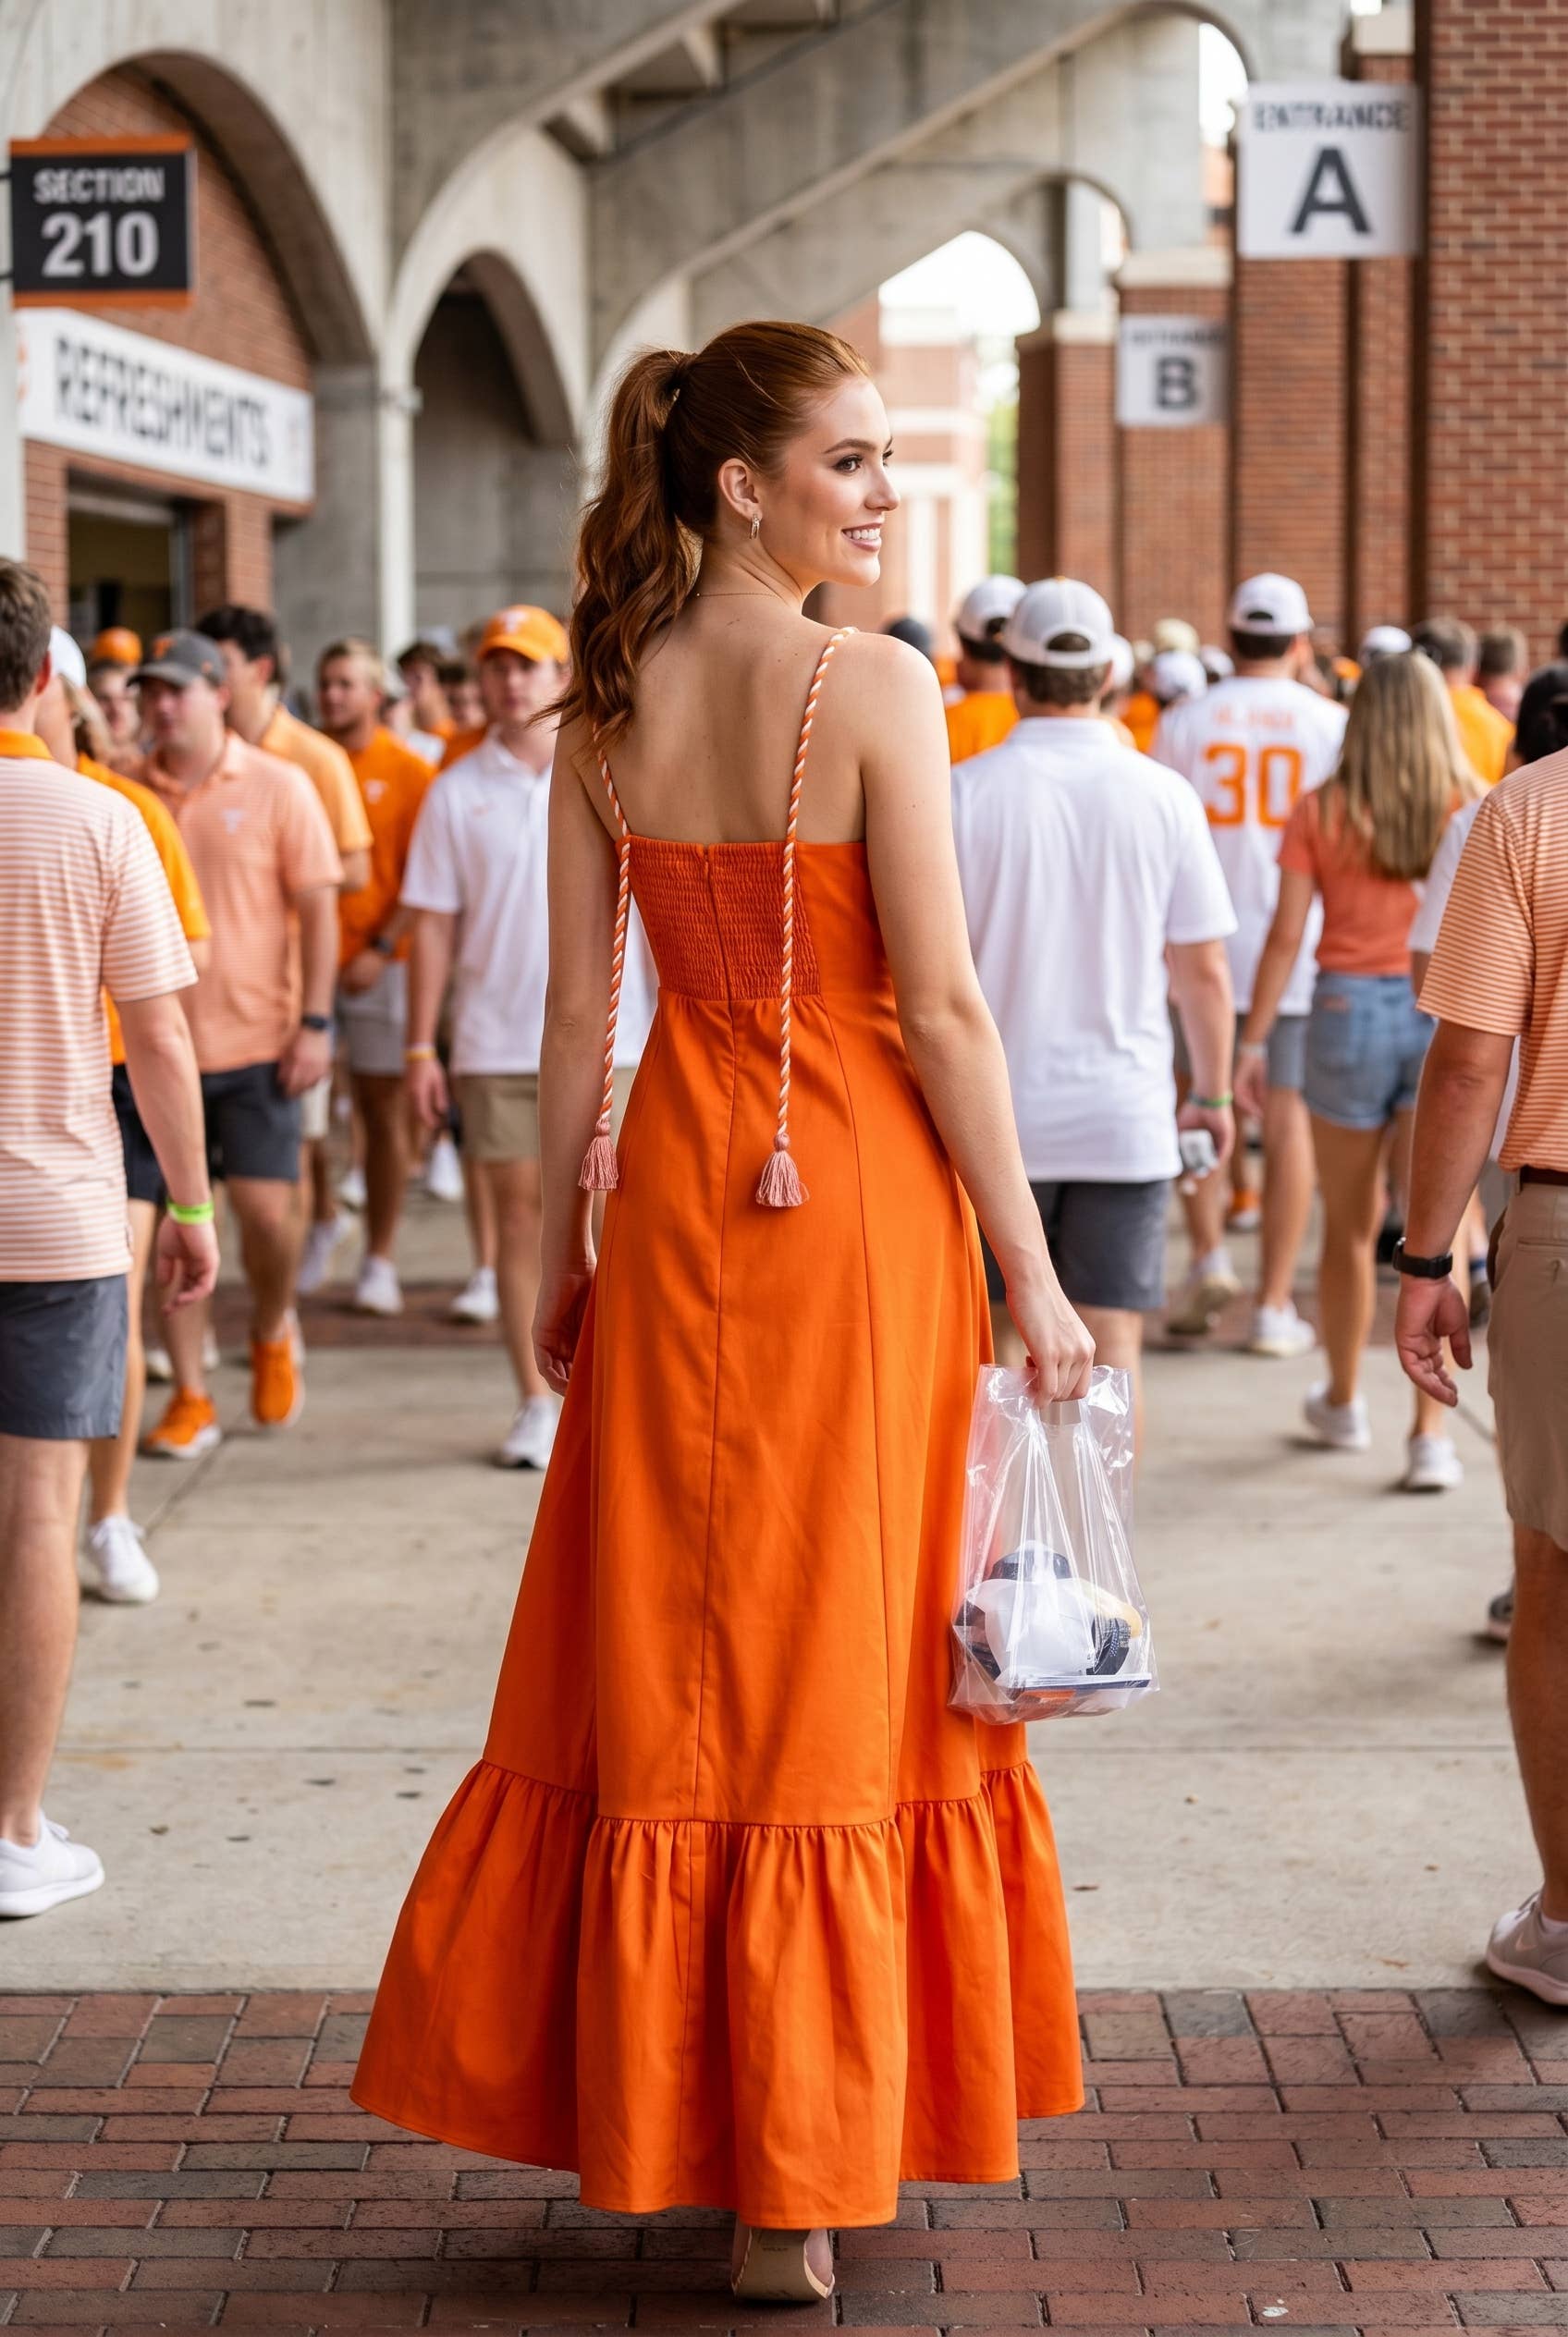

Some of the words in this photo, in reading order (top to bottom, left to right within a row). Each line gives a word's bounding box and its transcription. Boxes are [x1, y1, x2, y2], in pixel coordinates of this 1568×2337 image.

[33, 166, 165, 205] SECTION
[1290, 147, 1370, 235] A
[42, 211, 160, 277] 210
[1156, 356, 1198, 410] B
[1204, 743, 1303, 826] 30
